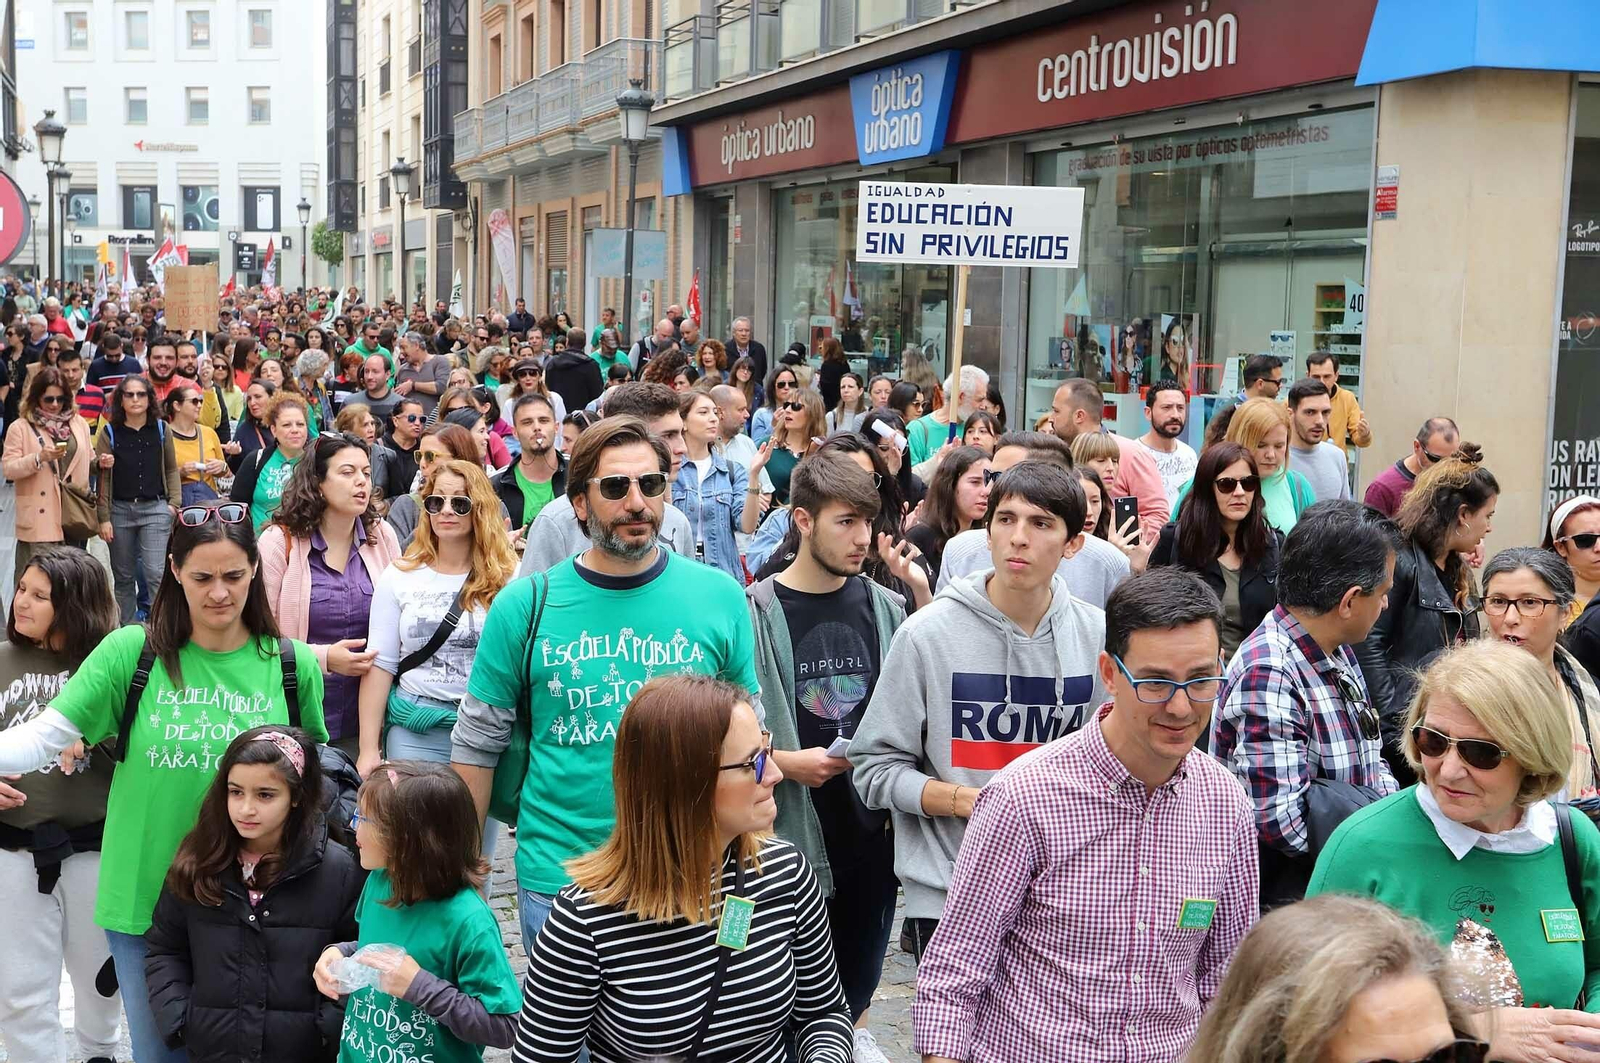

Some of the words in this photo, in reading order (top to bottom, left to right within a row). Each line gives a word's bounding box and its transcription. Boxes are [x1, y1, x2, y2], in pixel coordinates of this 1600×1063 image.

[1037, 1, 1238, 103] centrovisión
[871, 68, 923, 120] óptica
[721, 121, 761, 174] óptica
[764, 110, 815, 156] urbano
[864, 111, 922, 154] urbano
[1119, 147, 1131, 166] de
[1133, 149, 1145, 164] su
[1148, 143, 1173, 162] vista
[1175, 143, 1193, 164] por
[1196, 136, 1237, 161] ópticos
[1241, 124, 1330, 155] optometristas
[867, 185, 945, 198] IGUALDAD
[867, 201, 1013, 227] EDUCACIÓN
[865, 232, 905, 255] SIN
[920, 233, 1069, 260] PRIVILEGIOS
[542, 635, 630, 667] ESCUELA
[157, 687, 221, 709] ESCUELA
[566, 684, 608, 711] DE
[164, 724, 193, 741] DE
[557, 720, 616, 746] PARA
[952, 701, 1084, 743] ROMA
[149, 752, 198, 769] PARA
